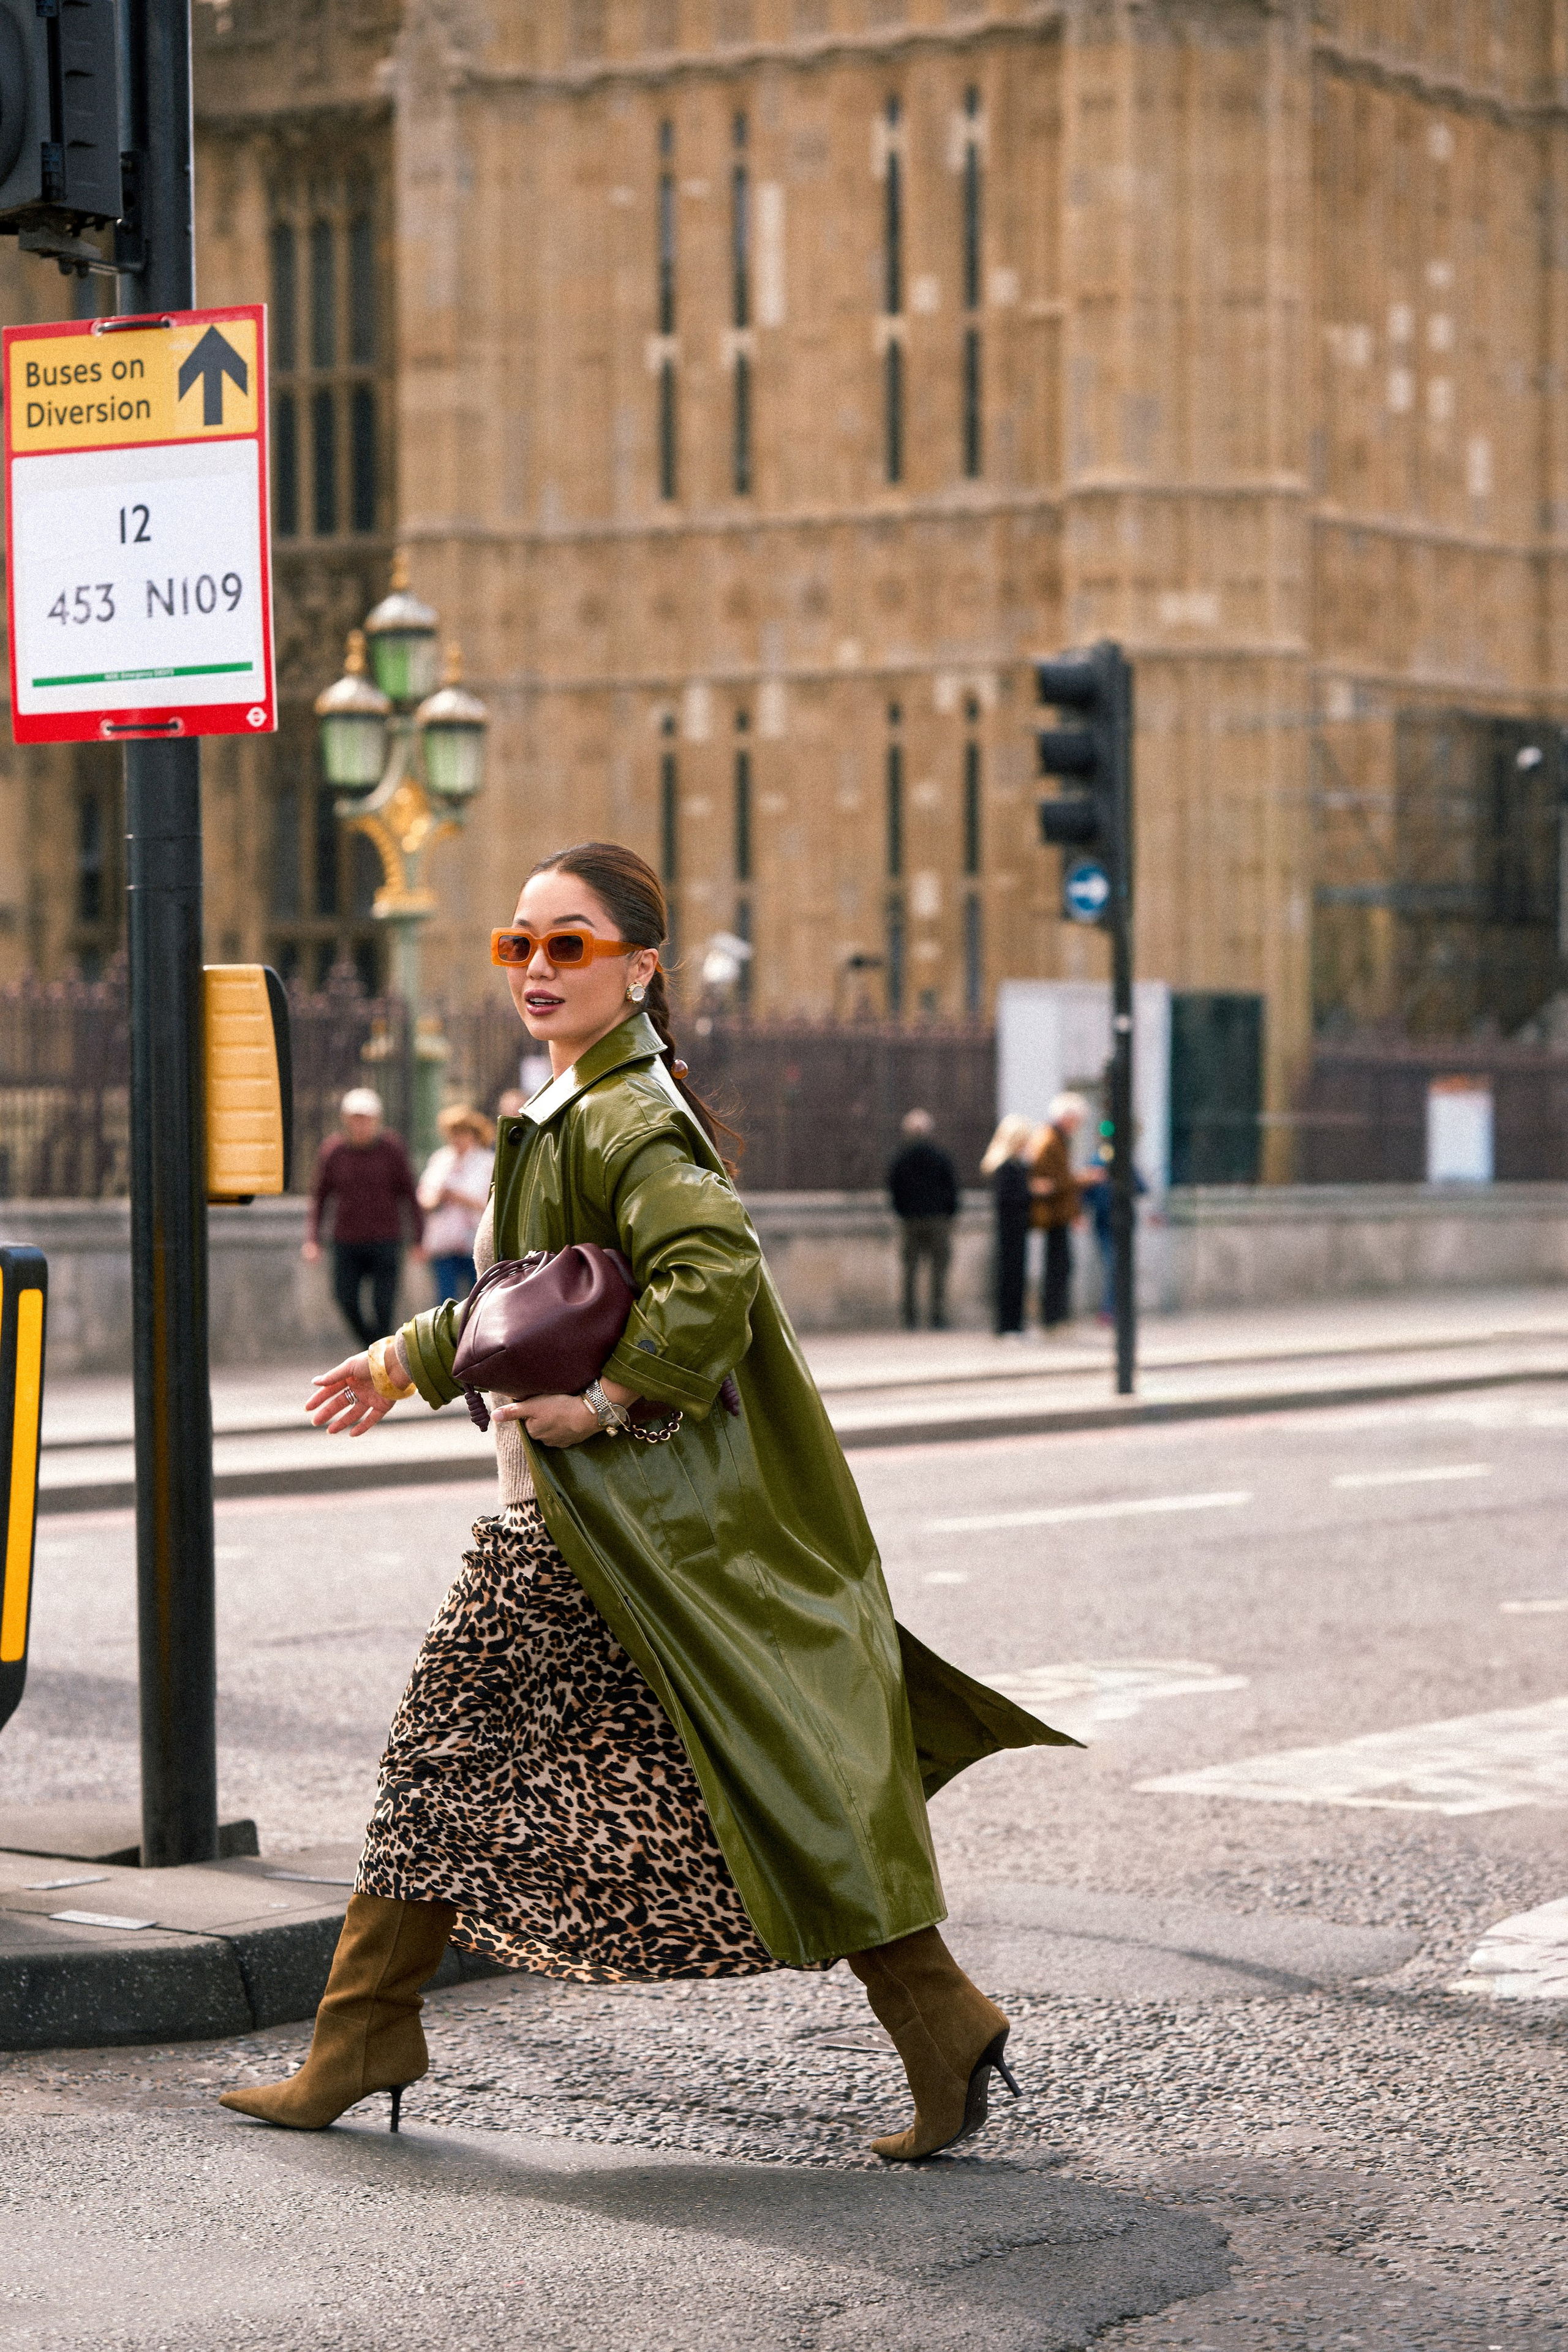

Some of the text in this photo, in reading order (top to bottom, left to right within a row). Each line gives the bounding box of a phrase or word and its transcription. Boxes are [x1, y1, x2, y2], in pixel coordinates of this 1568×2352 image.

[26, 359, 144, 387] Buses on
[27, 396, 150, 428] Diversion
[121, 505, 151, 543] 12
[48, 573, 241, 624] 453 N109
